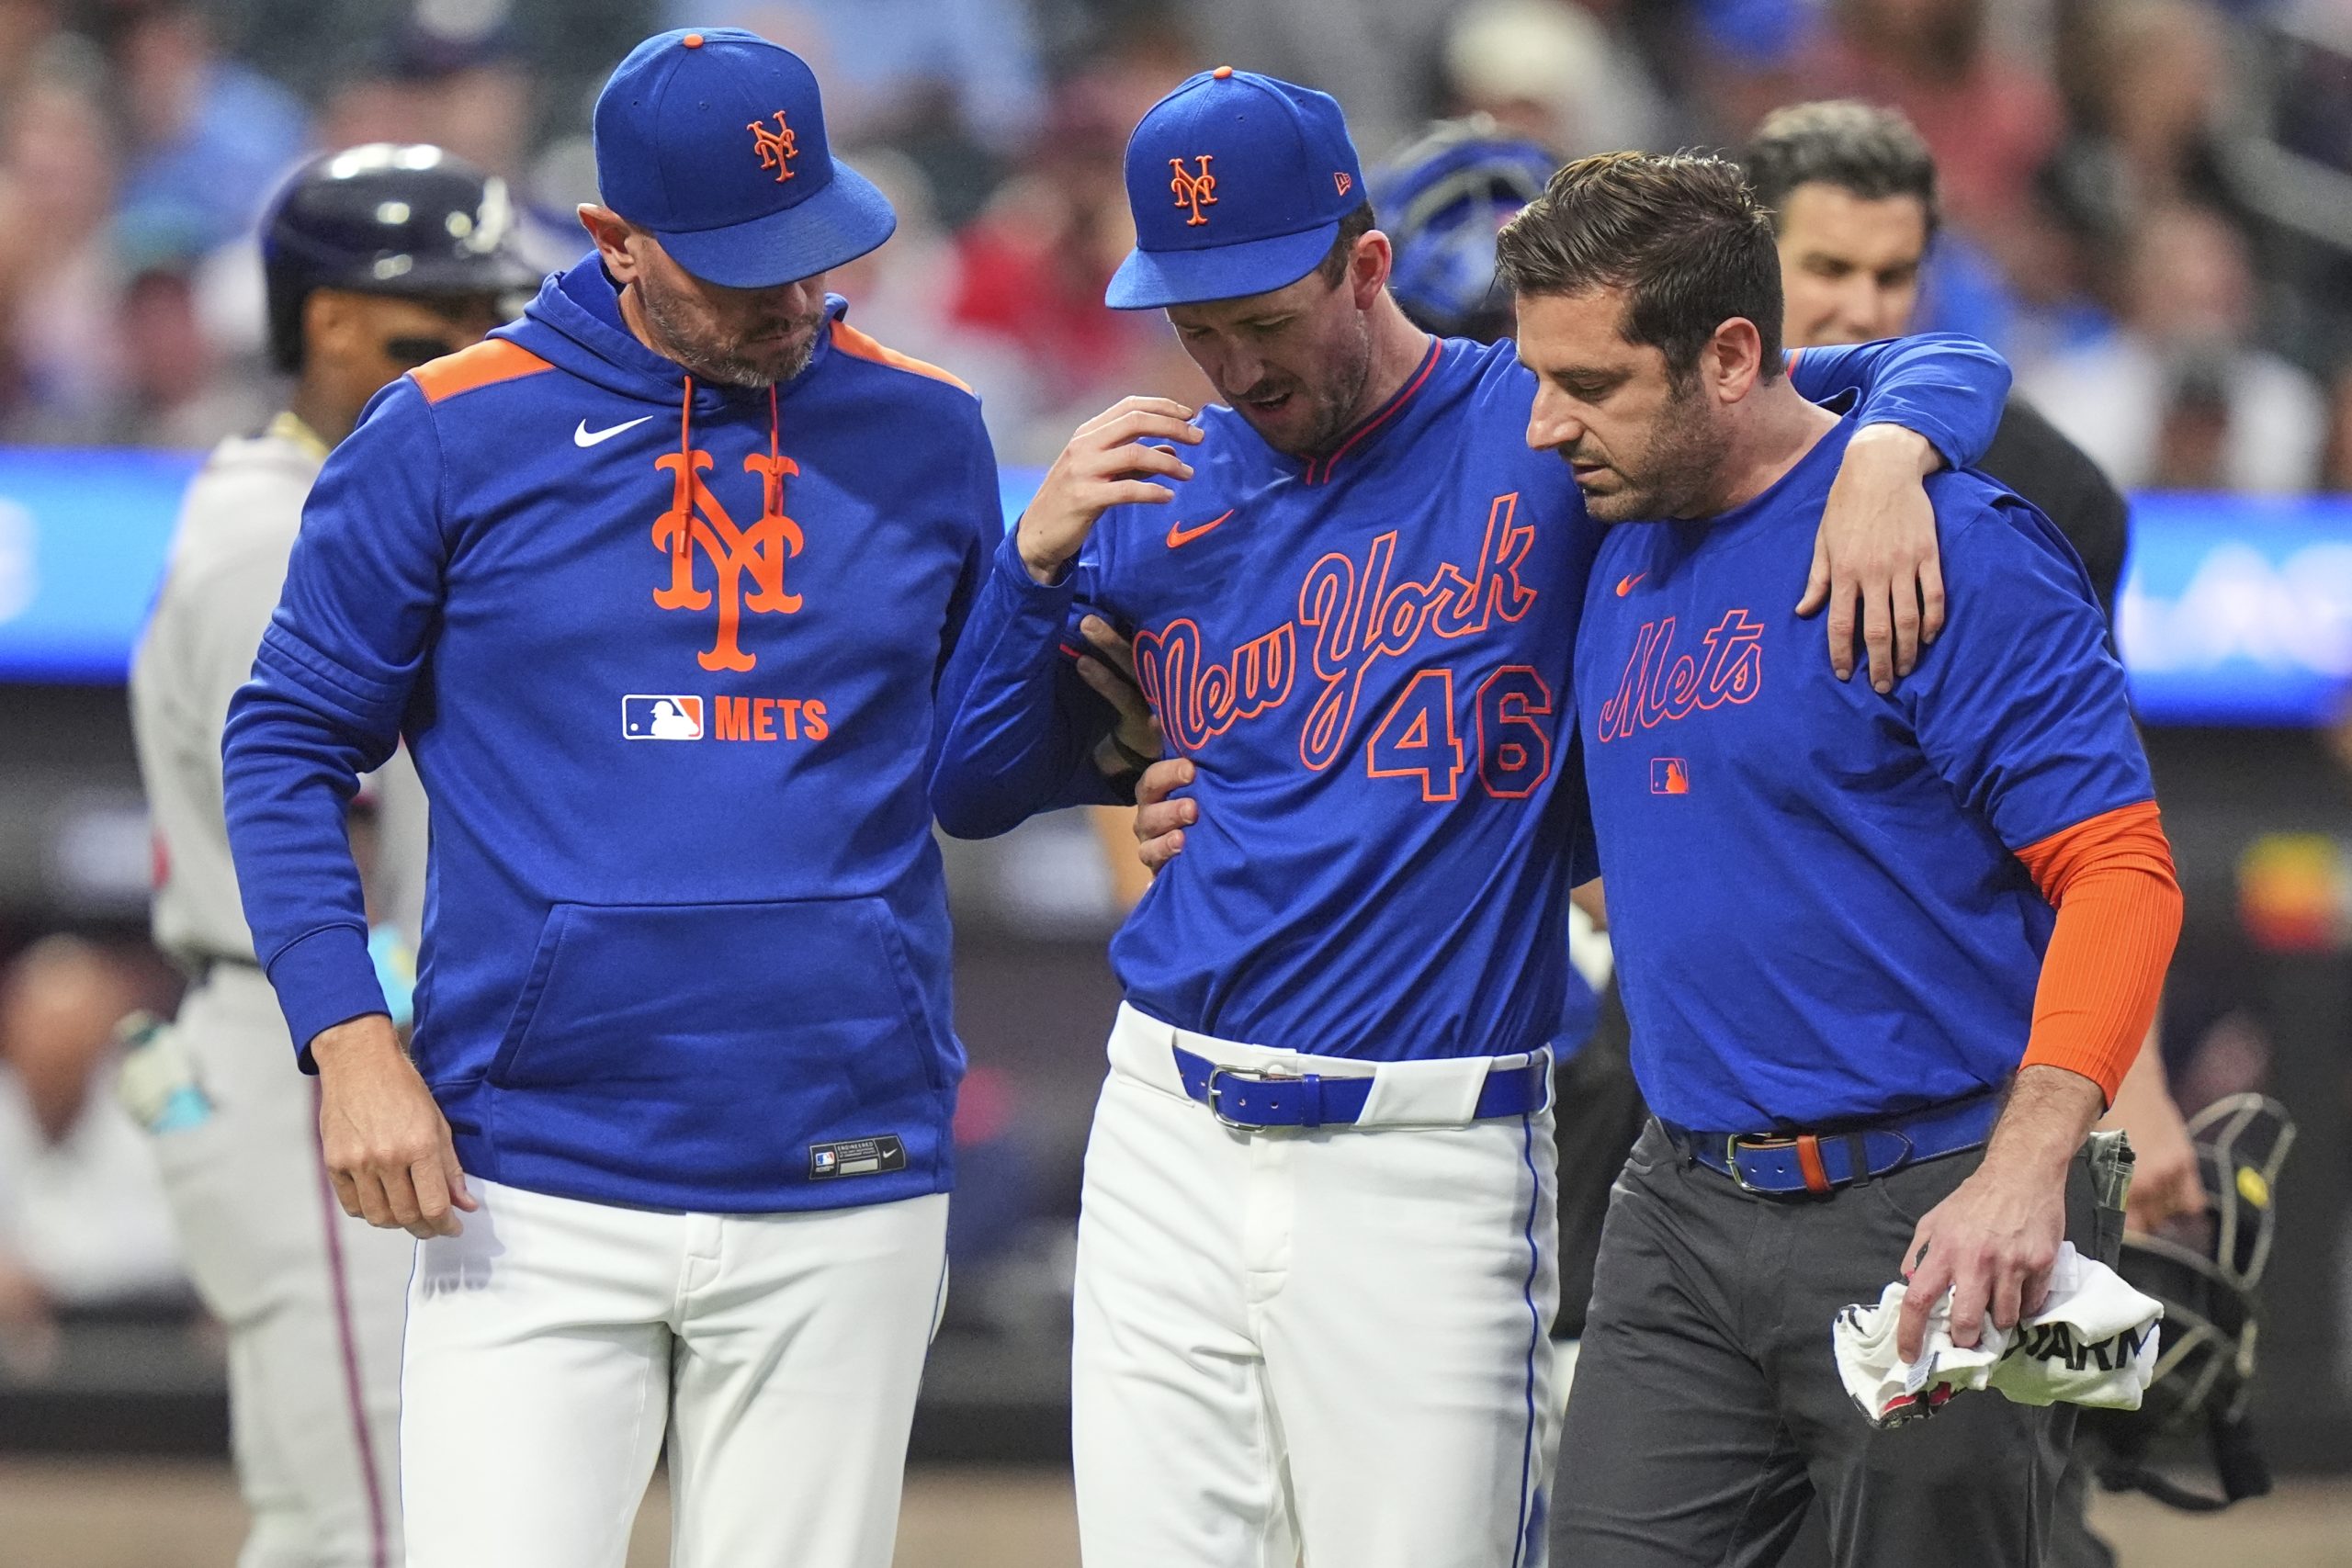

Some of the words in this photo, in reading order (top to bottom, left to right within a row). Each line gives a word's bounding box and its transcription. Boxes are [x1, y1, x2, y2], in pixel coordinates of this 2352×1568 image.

[1133, 618, 1296, 759] New
[1298, 492, 1538, 771] York
[1599, 609, 1765, 742] Mets
[714, 695, 829, 741] METS
[1367, 665, 1552, 802] 46
